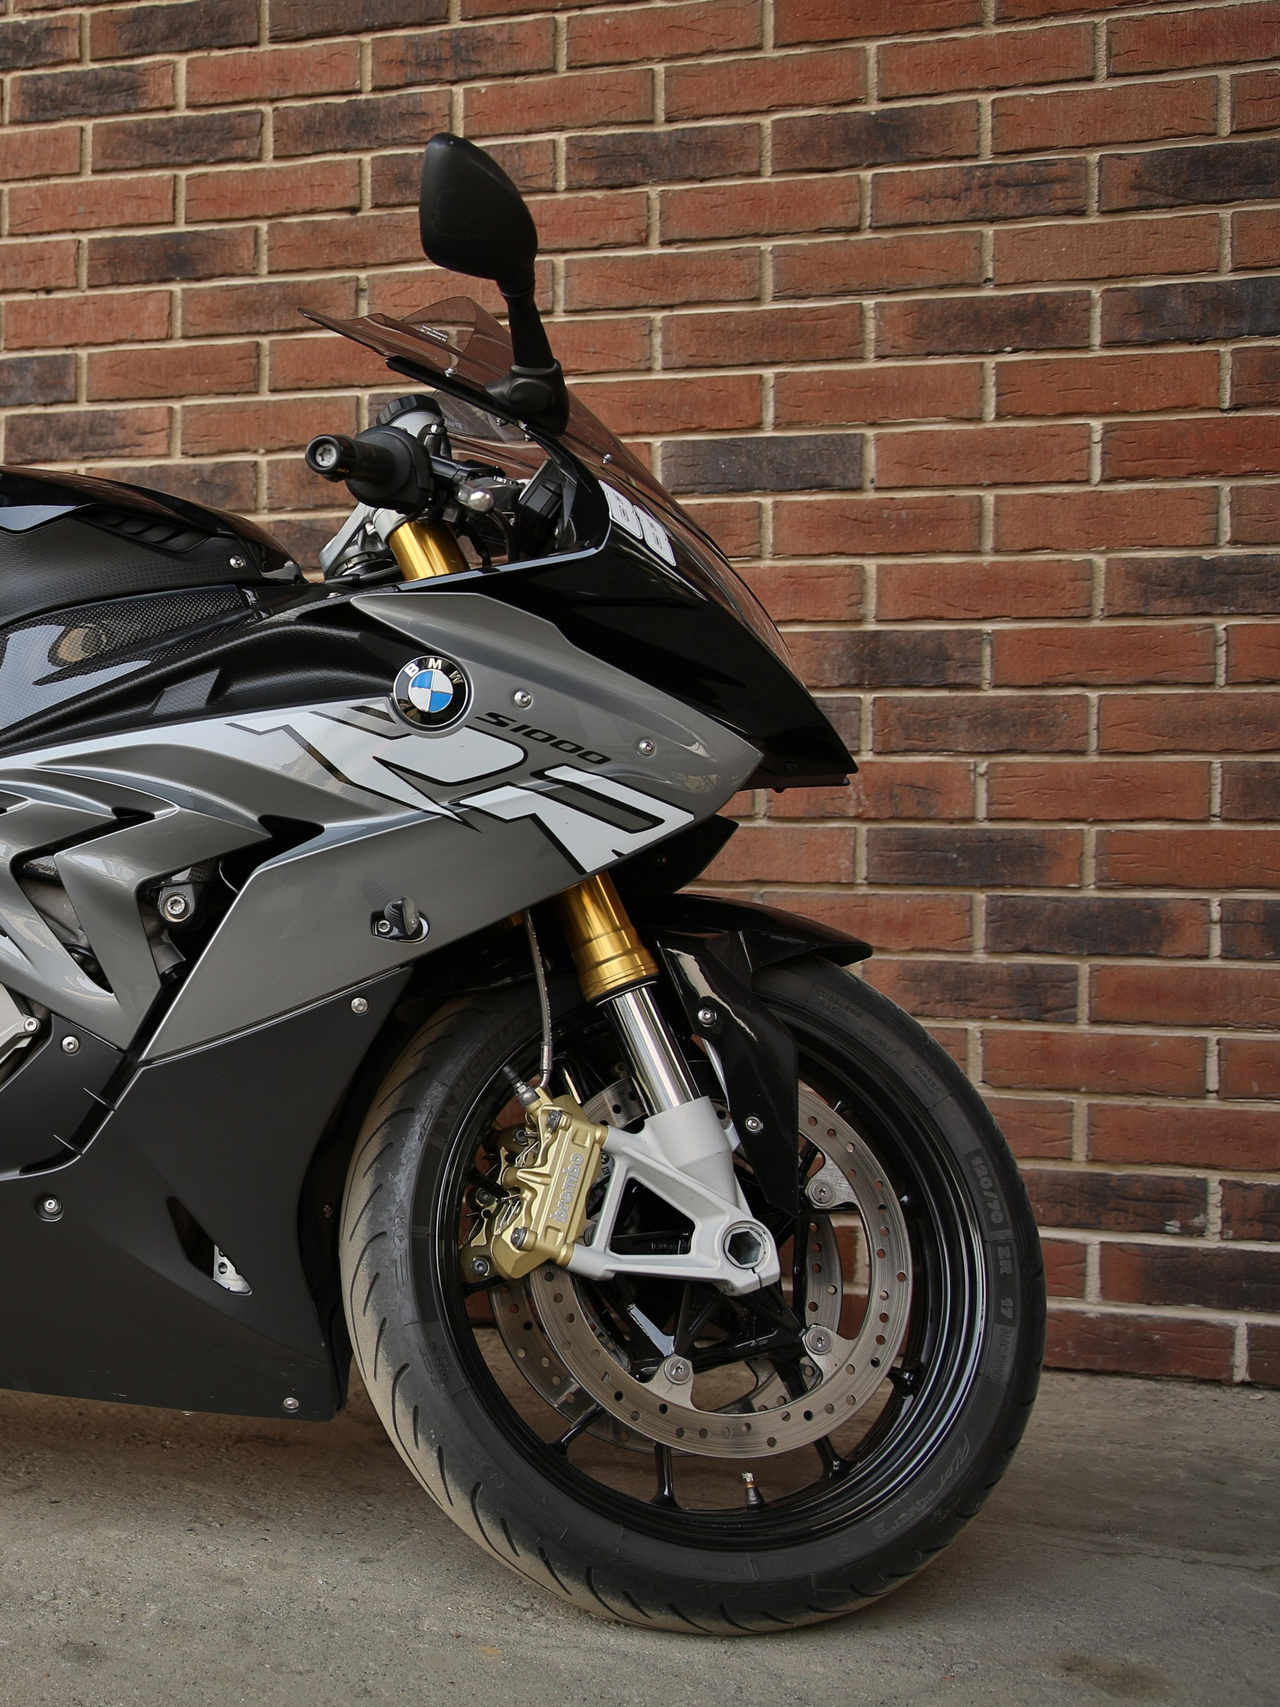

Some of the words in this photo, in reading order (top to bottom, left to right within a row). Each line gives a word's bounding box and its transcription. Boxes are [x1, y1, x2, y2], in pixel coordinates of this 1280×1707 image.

[474, 711, 612, 766] S1000
[817, 998, 850, 1022] RADIAL
[858, 1024, 896, 1056] MICHELIN
[453, 1011, 527, 1102] MICHELIN
[549, 1152, 584, 1223] brembo
[970, 1155, 1004, 1225] 120/70
[997, 1245, 1013, 1275] ZR
[1000, 1297, 1013, 1319] 17
[871, 1520, 892, 1539] 3
